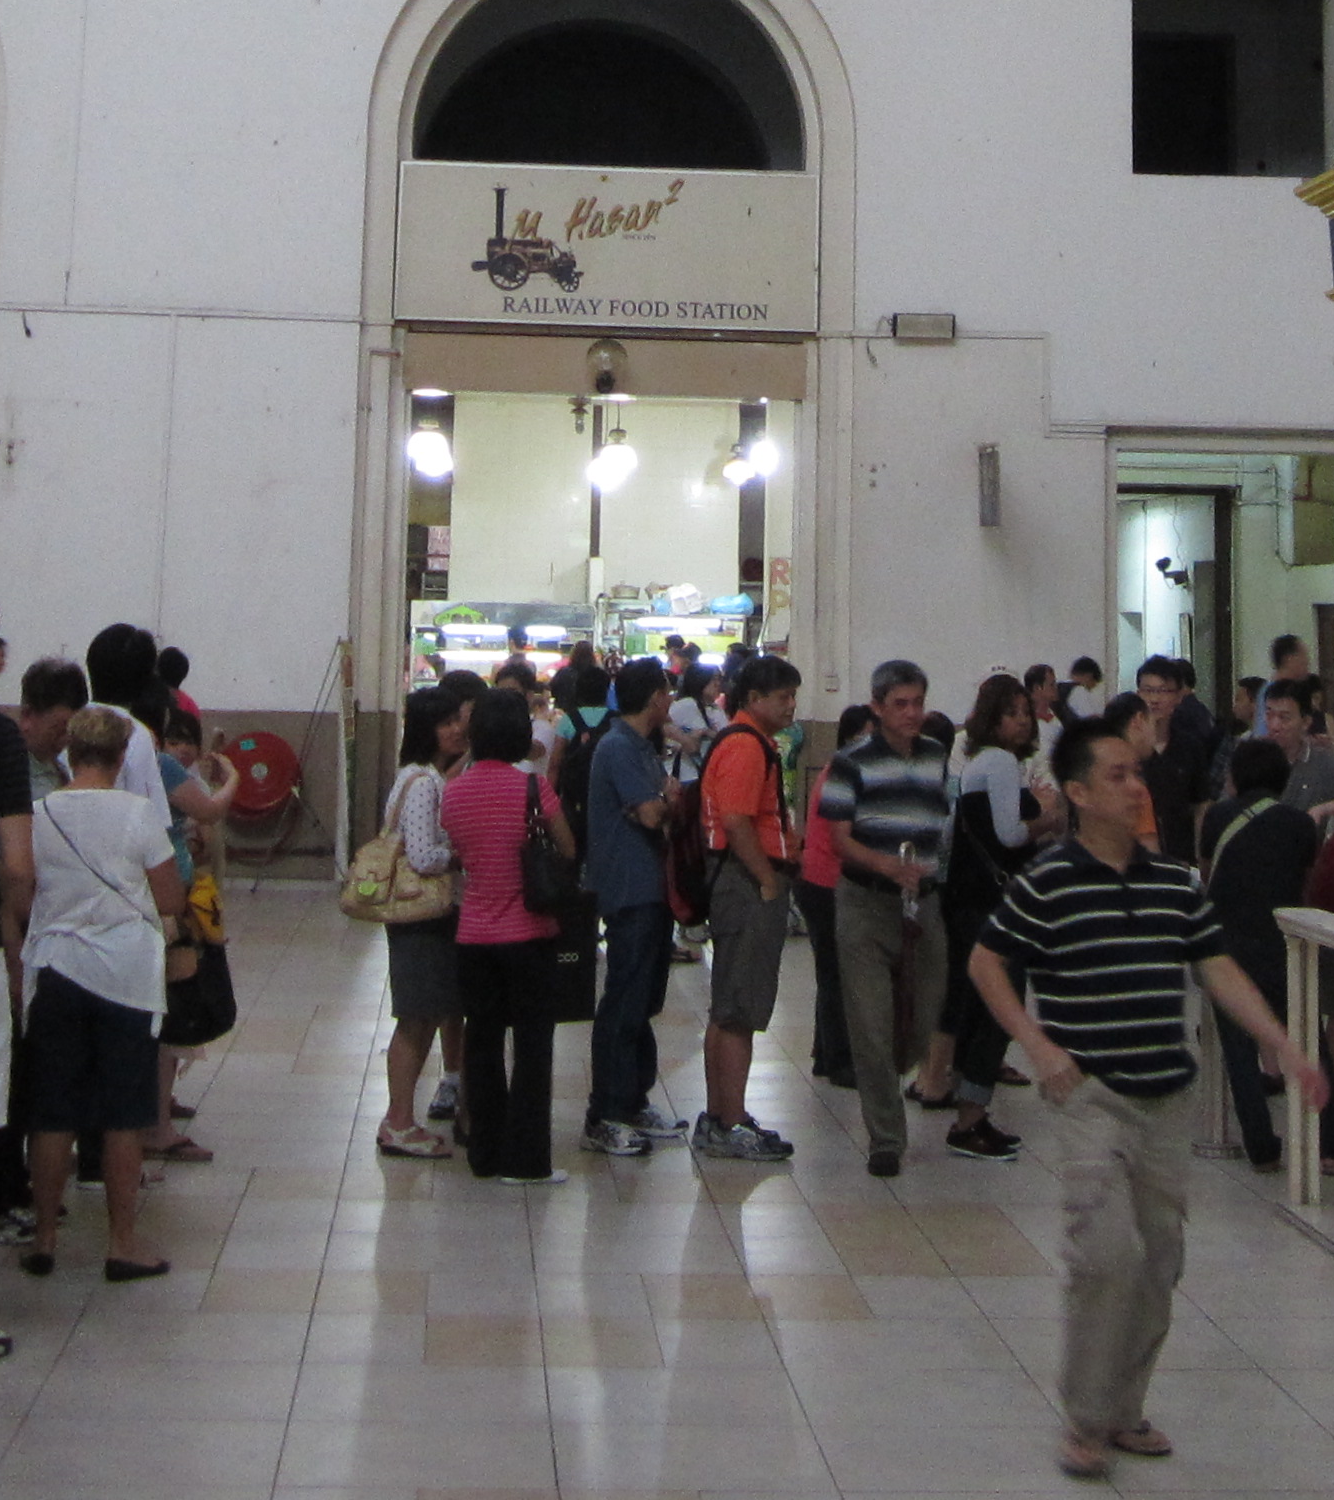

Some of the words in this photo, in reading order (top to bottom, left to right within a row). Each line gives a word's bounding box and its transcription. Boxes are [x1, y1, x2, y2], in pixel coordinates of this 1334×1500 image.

[503, 296, 603, 316] RAILWAY
[610, 299, 670, 318] FOOD
[676, 301, 769, 322] STATION
